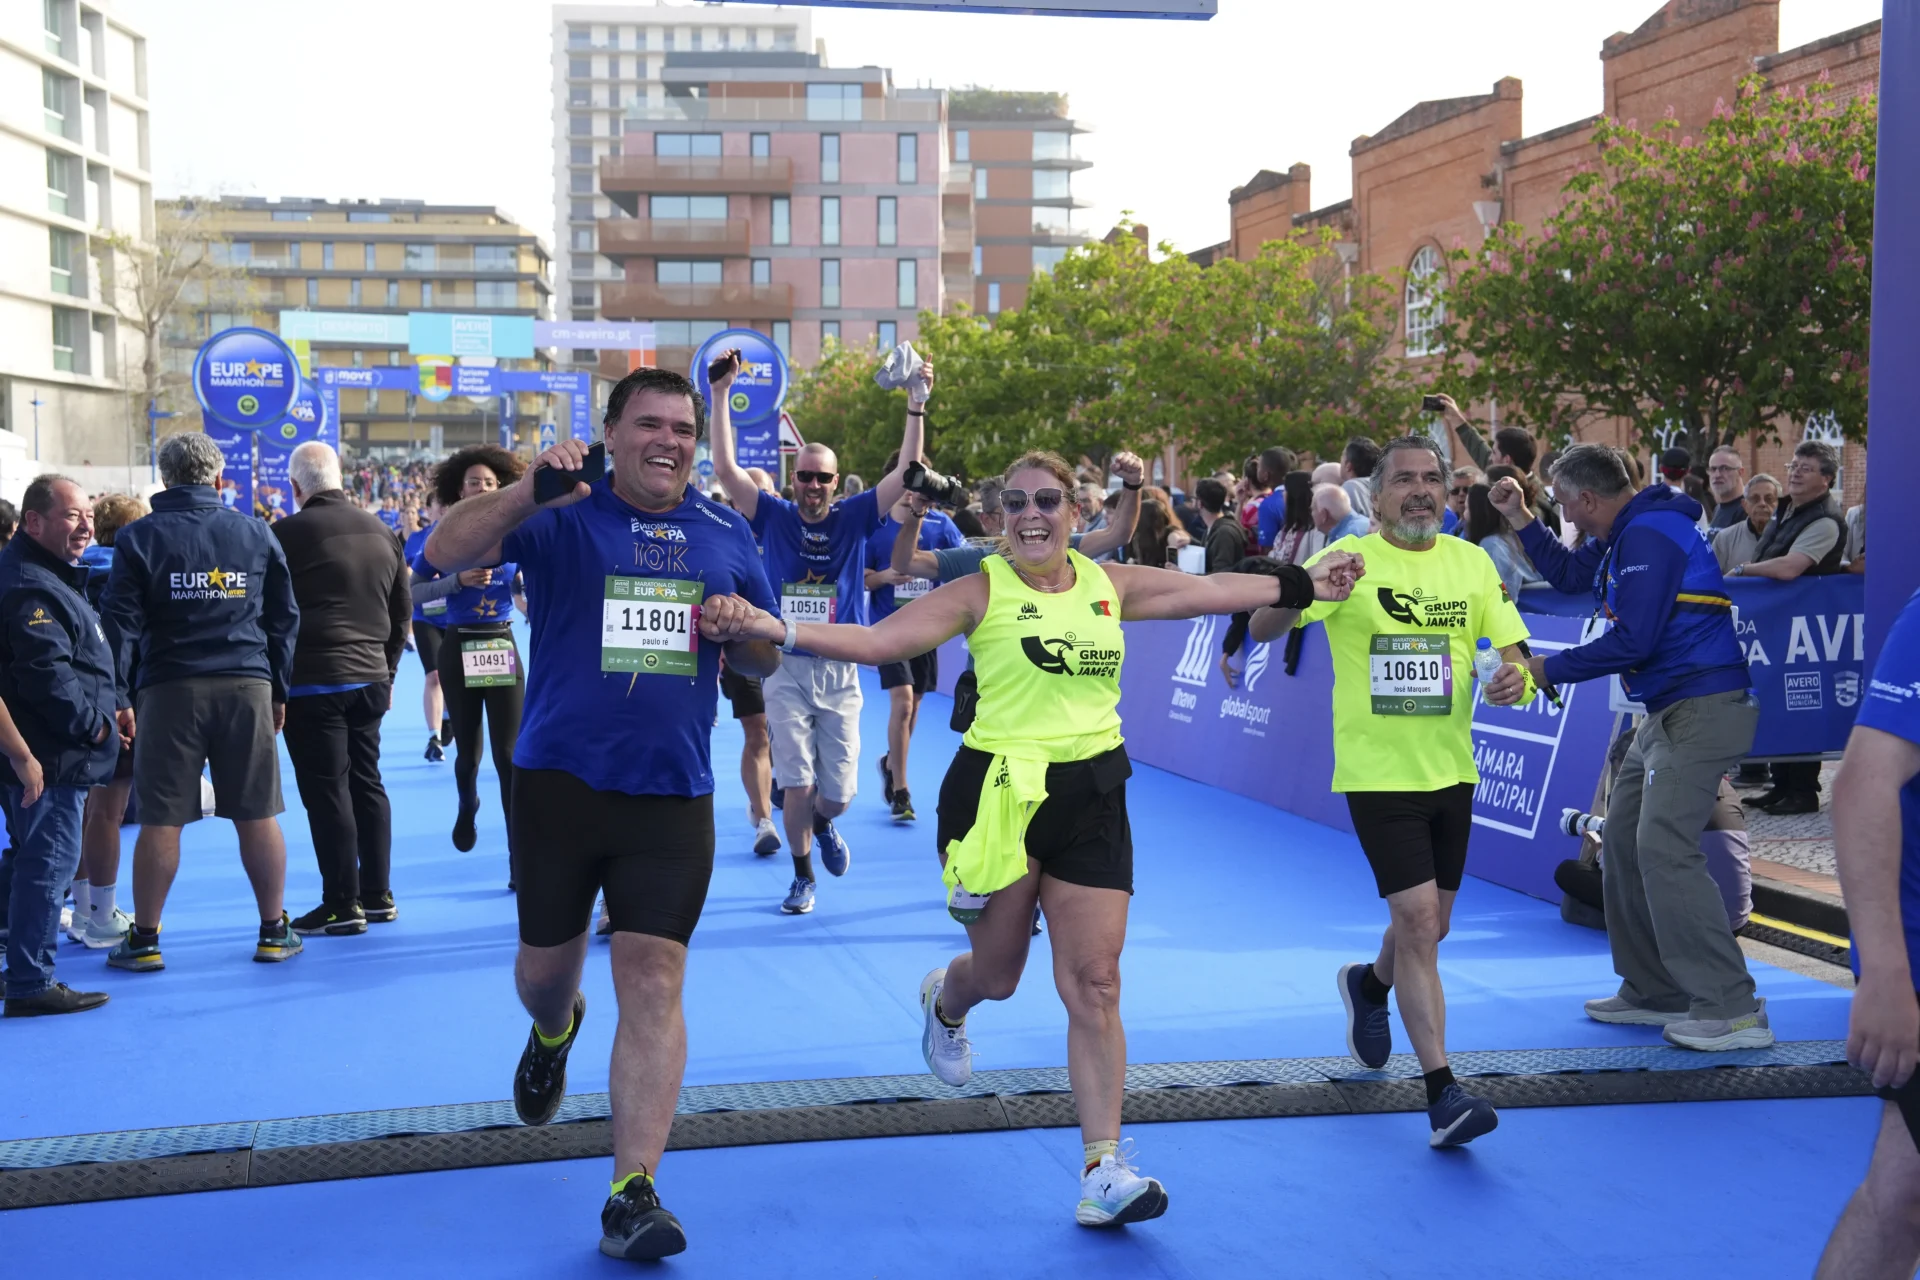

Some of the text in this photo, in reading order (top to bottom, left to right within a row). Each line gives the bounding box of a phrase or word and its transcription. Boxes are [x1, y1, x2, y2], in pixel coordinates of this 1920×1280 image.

[210, 377, 264, 387] MARATHON
[701, 506, 733, 529] DECATHLON
[1627, 564, 1650, 573] SPORT
[171, 589, 227, 600] MARATHON
[790, 600, 835, 614] 10516 E
[1424, 600, 1468, 612] GRUPO
[621, 608, 686, 633] 11801
[642, 637, 669, 646] paulo ré
[473, 653, 507, 667] 10491
[1079, 650, 1121, 660] GRUPO
[1384, 660, 1451, 681] 10610 D
[1787, 676, 1819, 688] AVEIRO
[1789, 698, 1821, 706] MUNICIPAL
[1220, 695, 1272, 726] globalsport
[1473, 740, 1525, 781] ÂMARA
